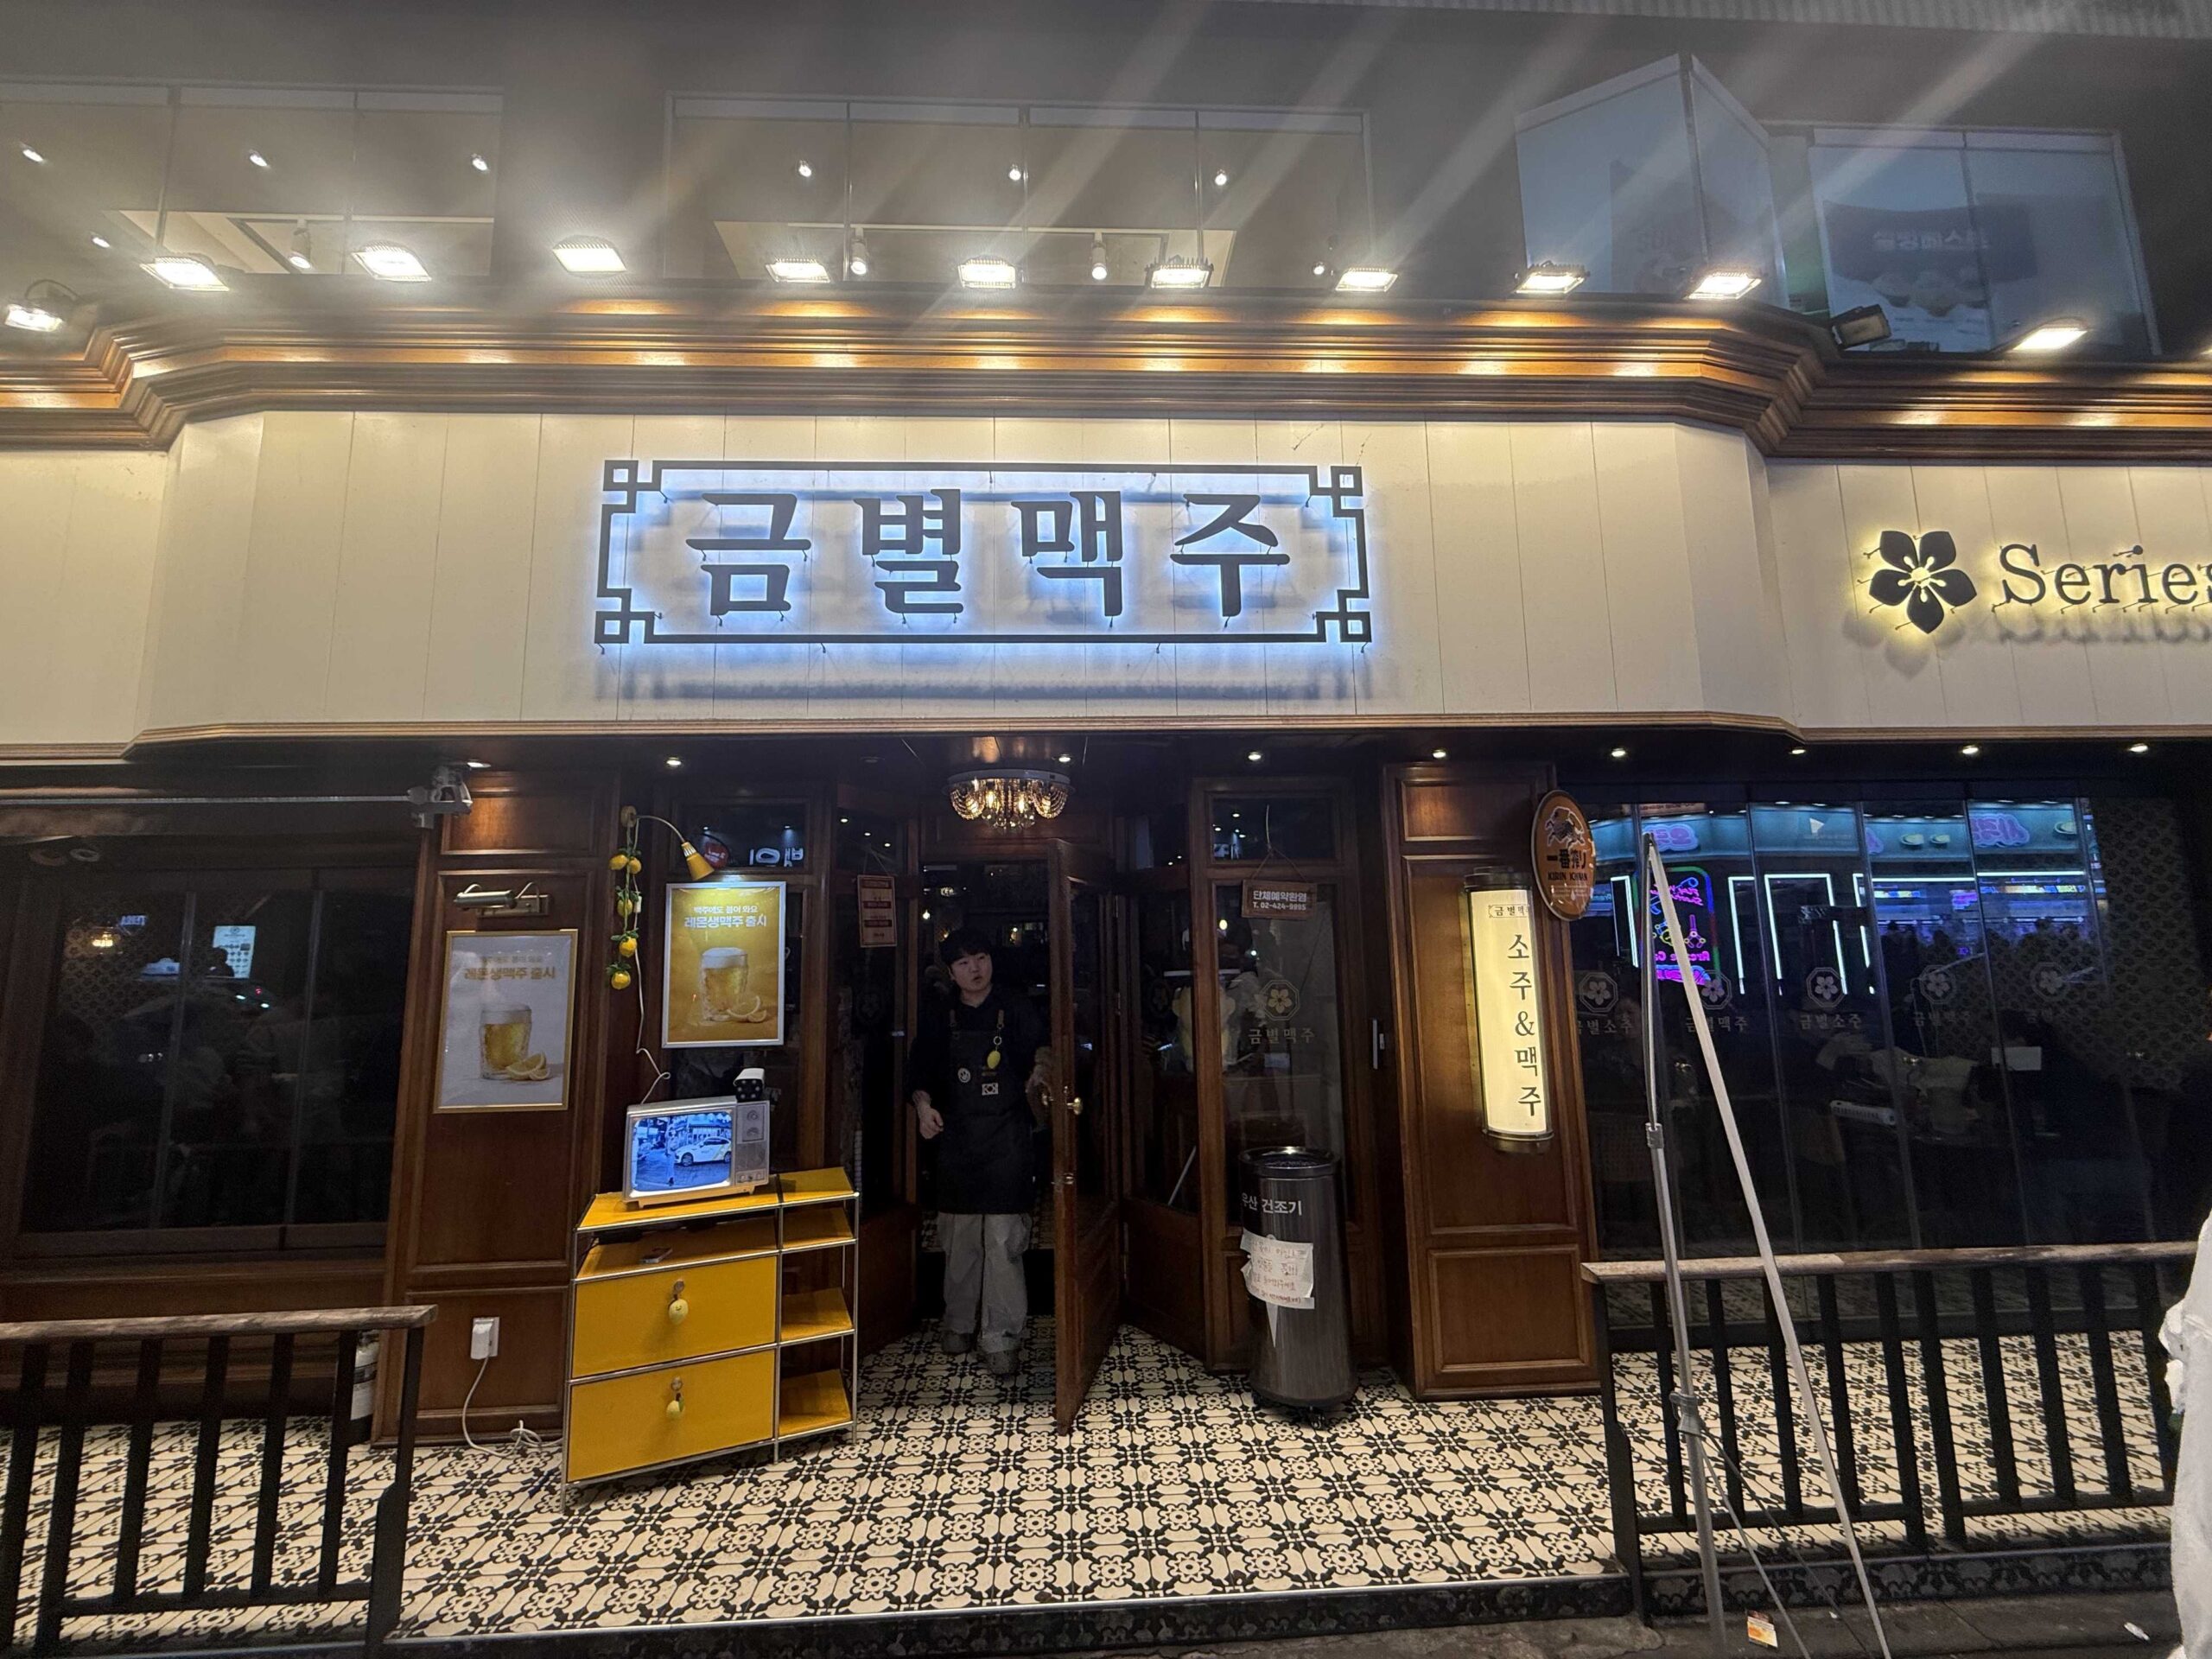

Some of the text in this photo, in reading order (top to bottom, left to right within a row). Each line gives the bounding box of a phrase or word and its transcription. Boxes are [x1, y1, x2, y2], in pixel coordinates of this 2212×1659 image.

[685, 487, 1291, 618] 금별맥주
[1548, 871, 1567, 880] KIRIN
[1494, 905, 1528, 916] 금별맥
[683, 914, 767, 929] 레몬생맥주 출시
[530, 966, 556, 981] 출시
[1799, 1013, 1863, 1030] 금별소주
[1248, 1027, 1315, 1045] 금별맥주
[1262, 1198, 1302, 1216] 건조기
